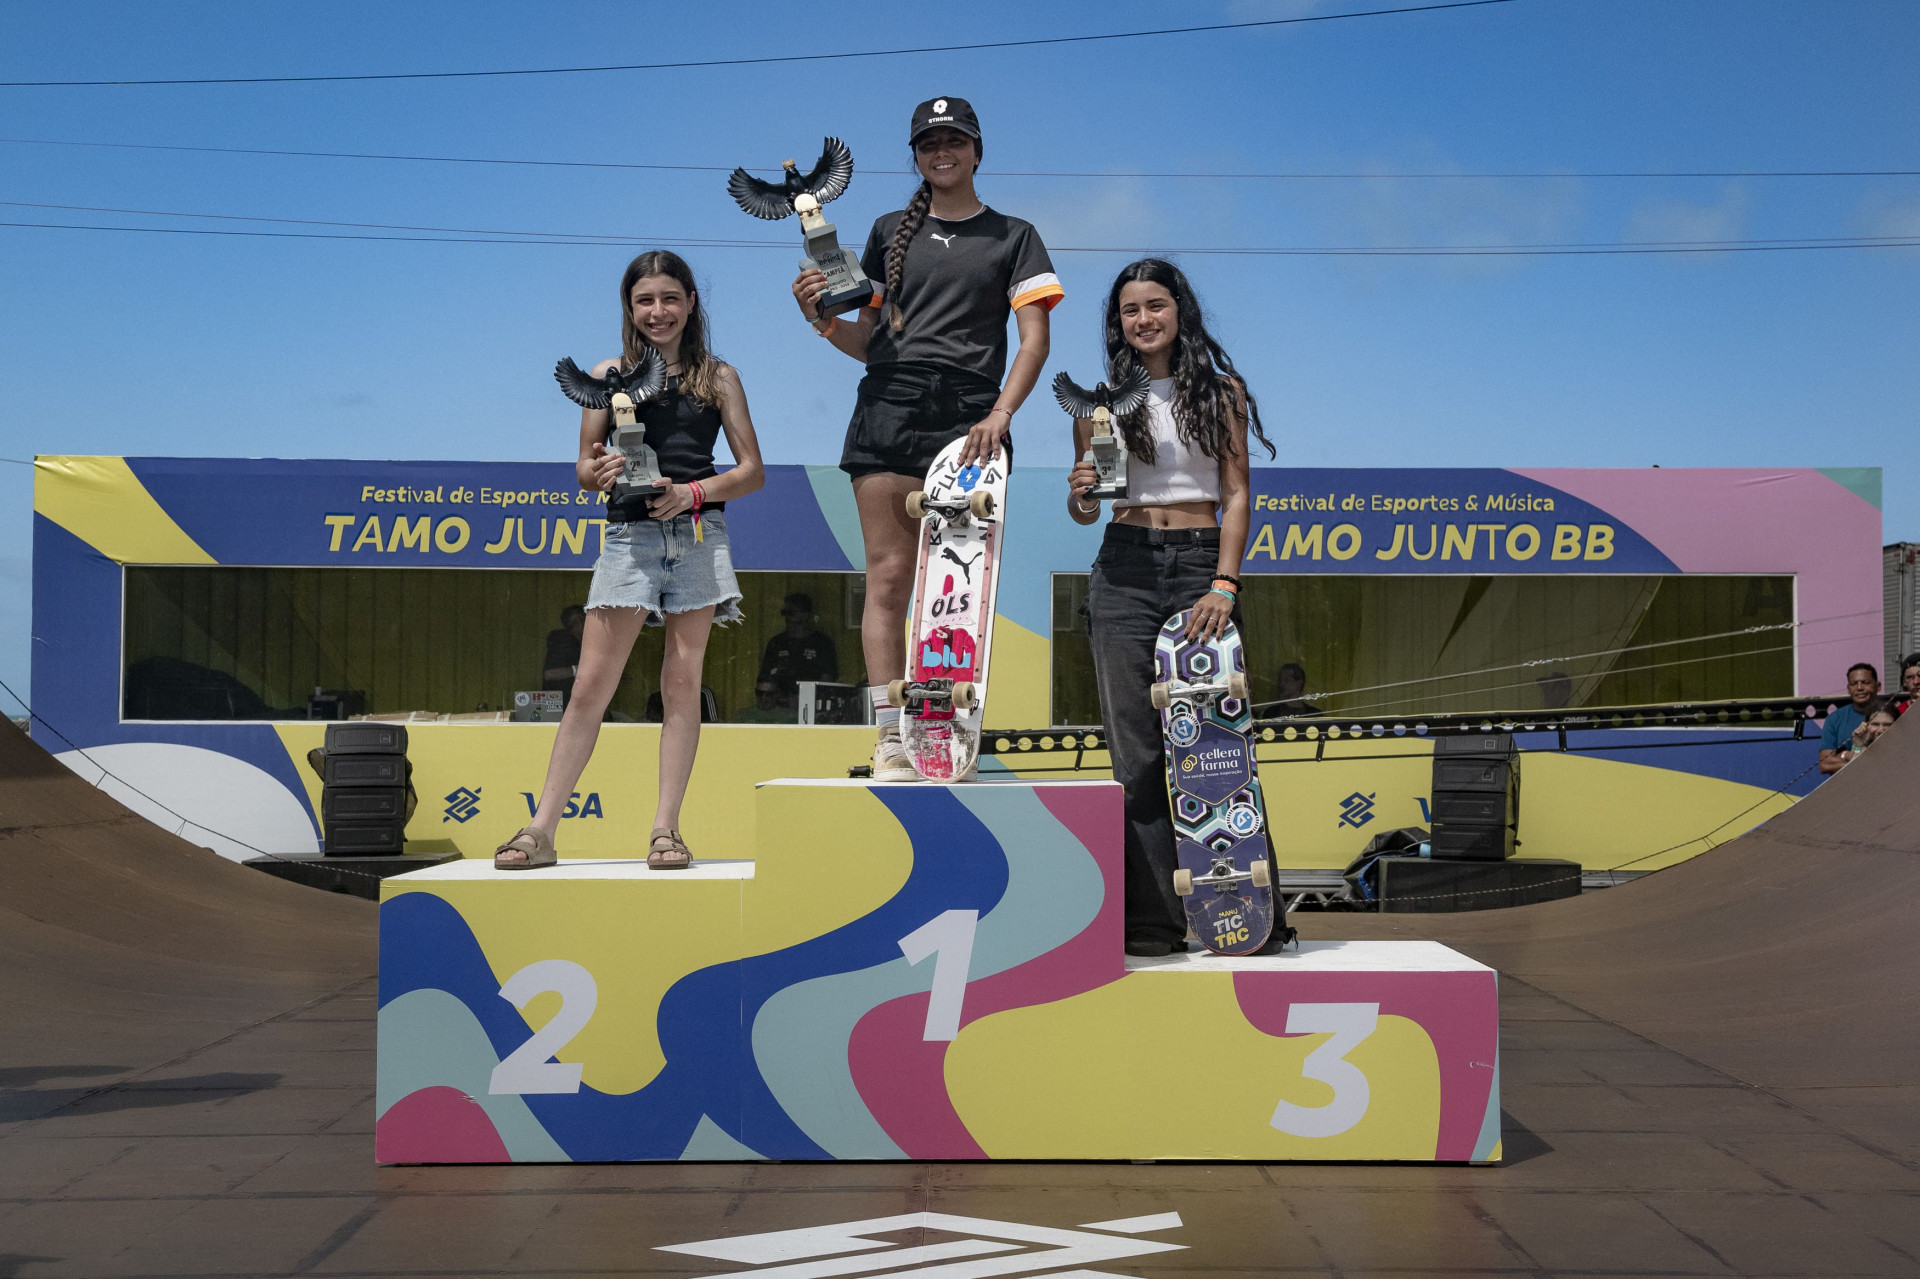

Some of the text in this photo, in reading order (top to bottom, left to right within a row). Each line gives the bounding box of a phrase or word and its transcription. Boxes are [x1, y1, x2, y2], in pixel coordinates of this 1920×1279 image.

[928, 116, 954, 124] STHORM
[361, 485, 443, 505] Festival
[450, 486, 474, 505] de
[481, 487, 570, 508] Esportes
[575, 488, 593, 505] &
[1254, 493, 1555, 515] Festival de Esportes & Música
[324, 515, 611, 555] TAMO JUNT
[1246, 524, 1615, 561] AMO JUNTO BB
[931, 593, 970, 618] OLS
[922, 644, 971, 668] blu
[1199, 748, 1241, 770] cellera
[1200, 760, 1239, 771] farma
[519, 792, 604, 819] VSA
[1213, 914, 1243, 935] TIC
[1218, 909, 1239, 918] MANU
[1214, 927, 1250, 949] TAC
[897, 909, 980, 1042] 1
[488, 959, 598, 1096] 2
[1269, 1002, 1381, 1138] 3
